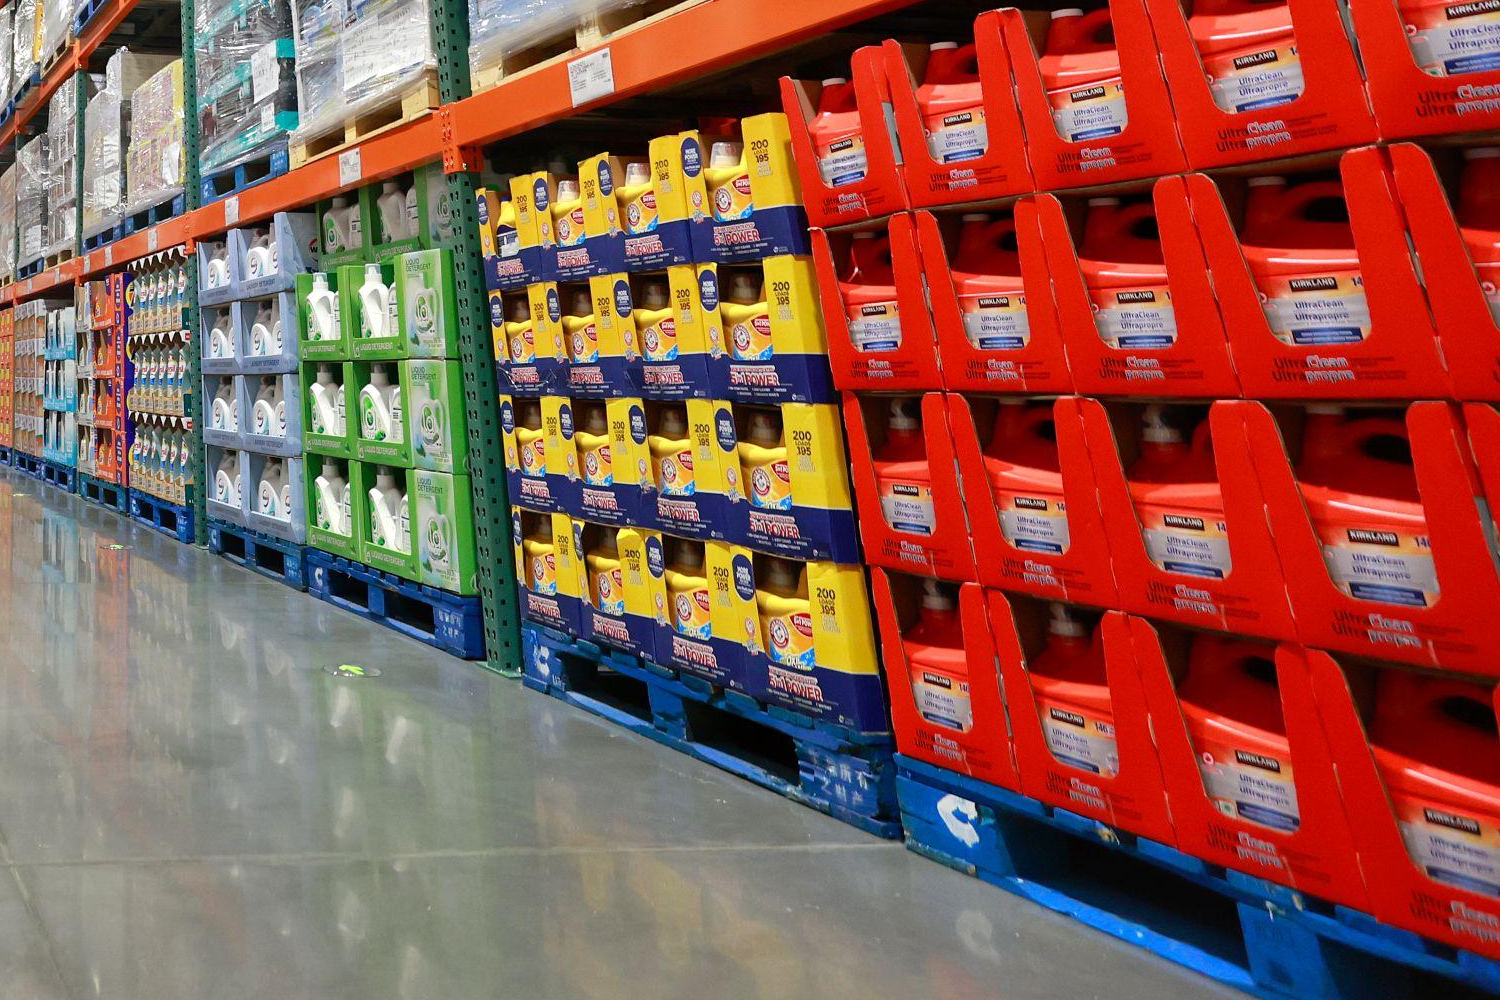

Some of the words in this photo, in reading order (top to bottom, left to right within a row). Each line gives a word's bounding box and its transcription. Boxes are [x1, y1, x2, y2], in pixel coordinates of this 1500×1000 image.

[1235, 51, 1276, 66] KIRKLAND
[1238, 71, 1284, 86] UltraClean
[1072, 87, 1104, 101] KIRKLAND
[1239, 81, 1289, 96] Ultrapropre
[1073, 104, 1110, 117] UltraClean
[1073, 114, 1113, 128] Ultrapropre
[751, 139, 769, 150] 200
[755, 153, 769, 163] 195
[405, 257, 421, 266] LIQUID
[405, 263, 432, 273] DETERGENT
[772, 281, 790, 292] 200
[1291, 278, 1336, 290] KIRKLAND
[776, 296, 790, 306] 195
[1118, 292, 1154, 303] KIRKLAND
[1294, 300, 1345, 310] UltraClean
[1120, 311, 1161, 320] UltraClean
[1295, 310, 1350, 323] Ultrapropre
[1120, 321, 1164, 332] Ultrapropre
[745, 372, 780, 386] POWER
[792, 430, 812, 441] 200
[795, 440, 811, 448] LOADS
[797, 446, 812, 456] 195
[417, 476, 432, 486] LIQUID
[417, 485, 443, 494] DETERGENT
[1165, 516, 1204, 528] KIRKLAND
[766, 521, 801, 539] POWER
[1166, 535, 1210, 549] UltraClean
[1349, 530, 1397, 544] KIRKLAND
[624, 549, 640, 559] 200
[1166, 546, 1213, 561] Ultrapropre
[1352, 552, 1405, 568] UltraClean
[1352, 564, 1412, 582] Ultrapropre
[816, 588, 836, 600] 200
[821, 604, 836, 616] 195
[786, 679, 823, 702] POWER
[1051, 709, 1084, 726] KIRKLAND
[1237, 752, 1279, 771] KIRKLAND
[1425, 809, 1479, 833] KIRKLAND
